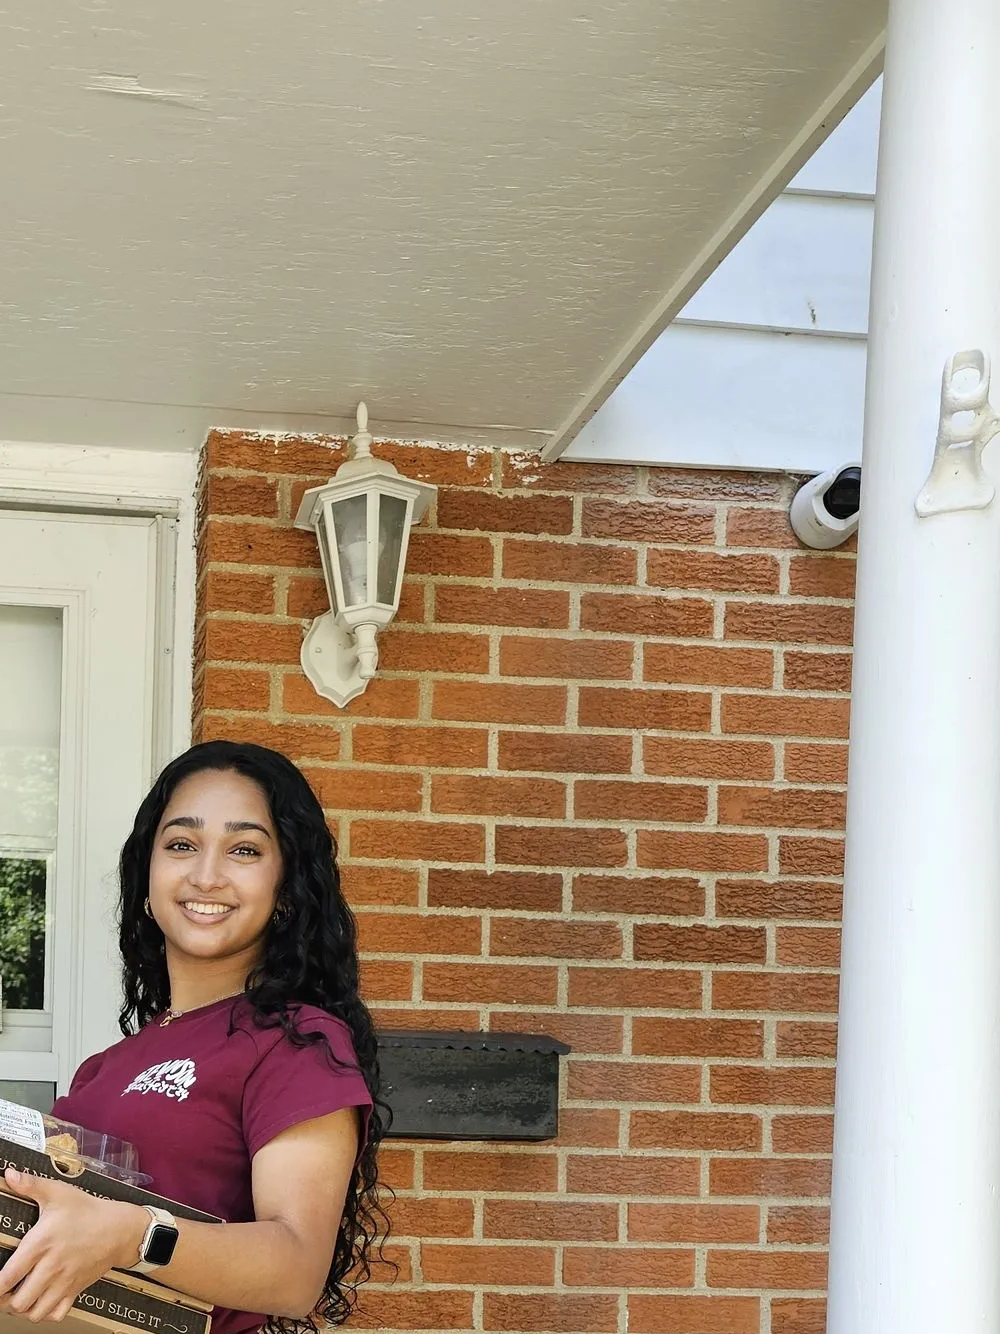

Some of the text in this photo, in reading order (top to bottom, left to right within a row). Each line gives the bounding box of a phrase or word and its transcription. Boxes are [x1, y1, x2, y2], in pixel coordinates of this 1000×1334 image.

[77, 1293, 161, 1329] YOU SLICE IT
